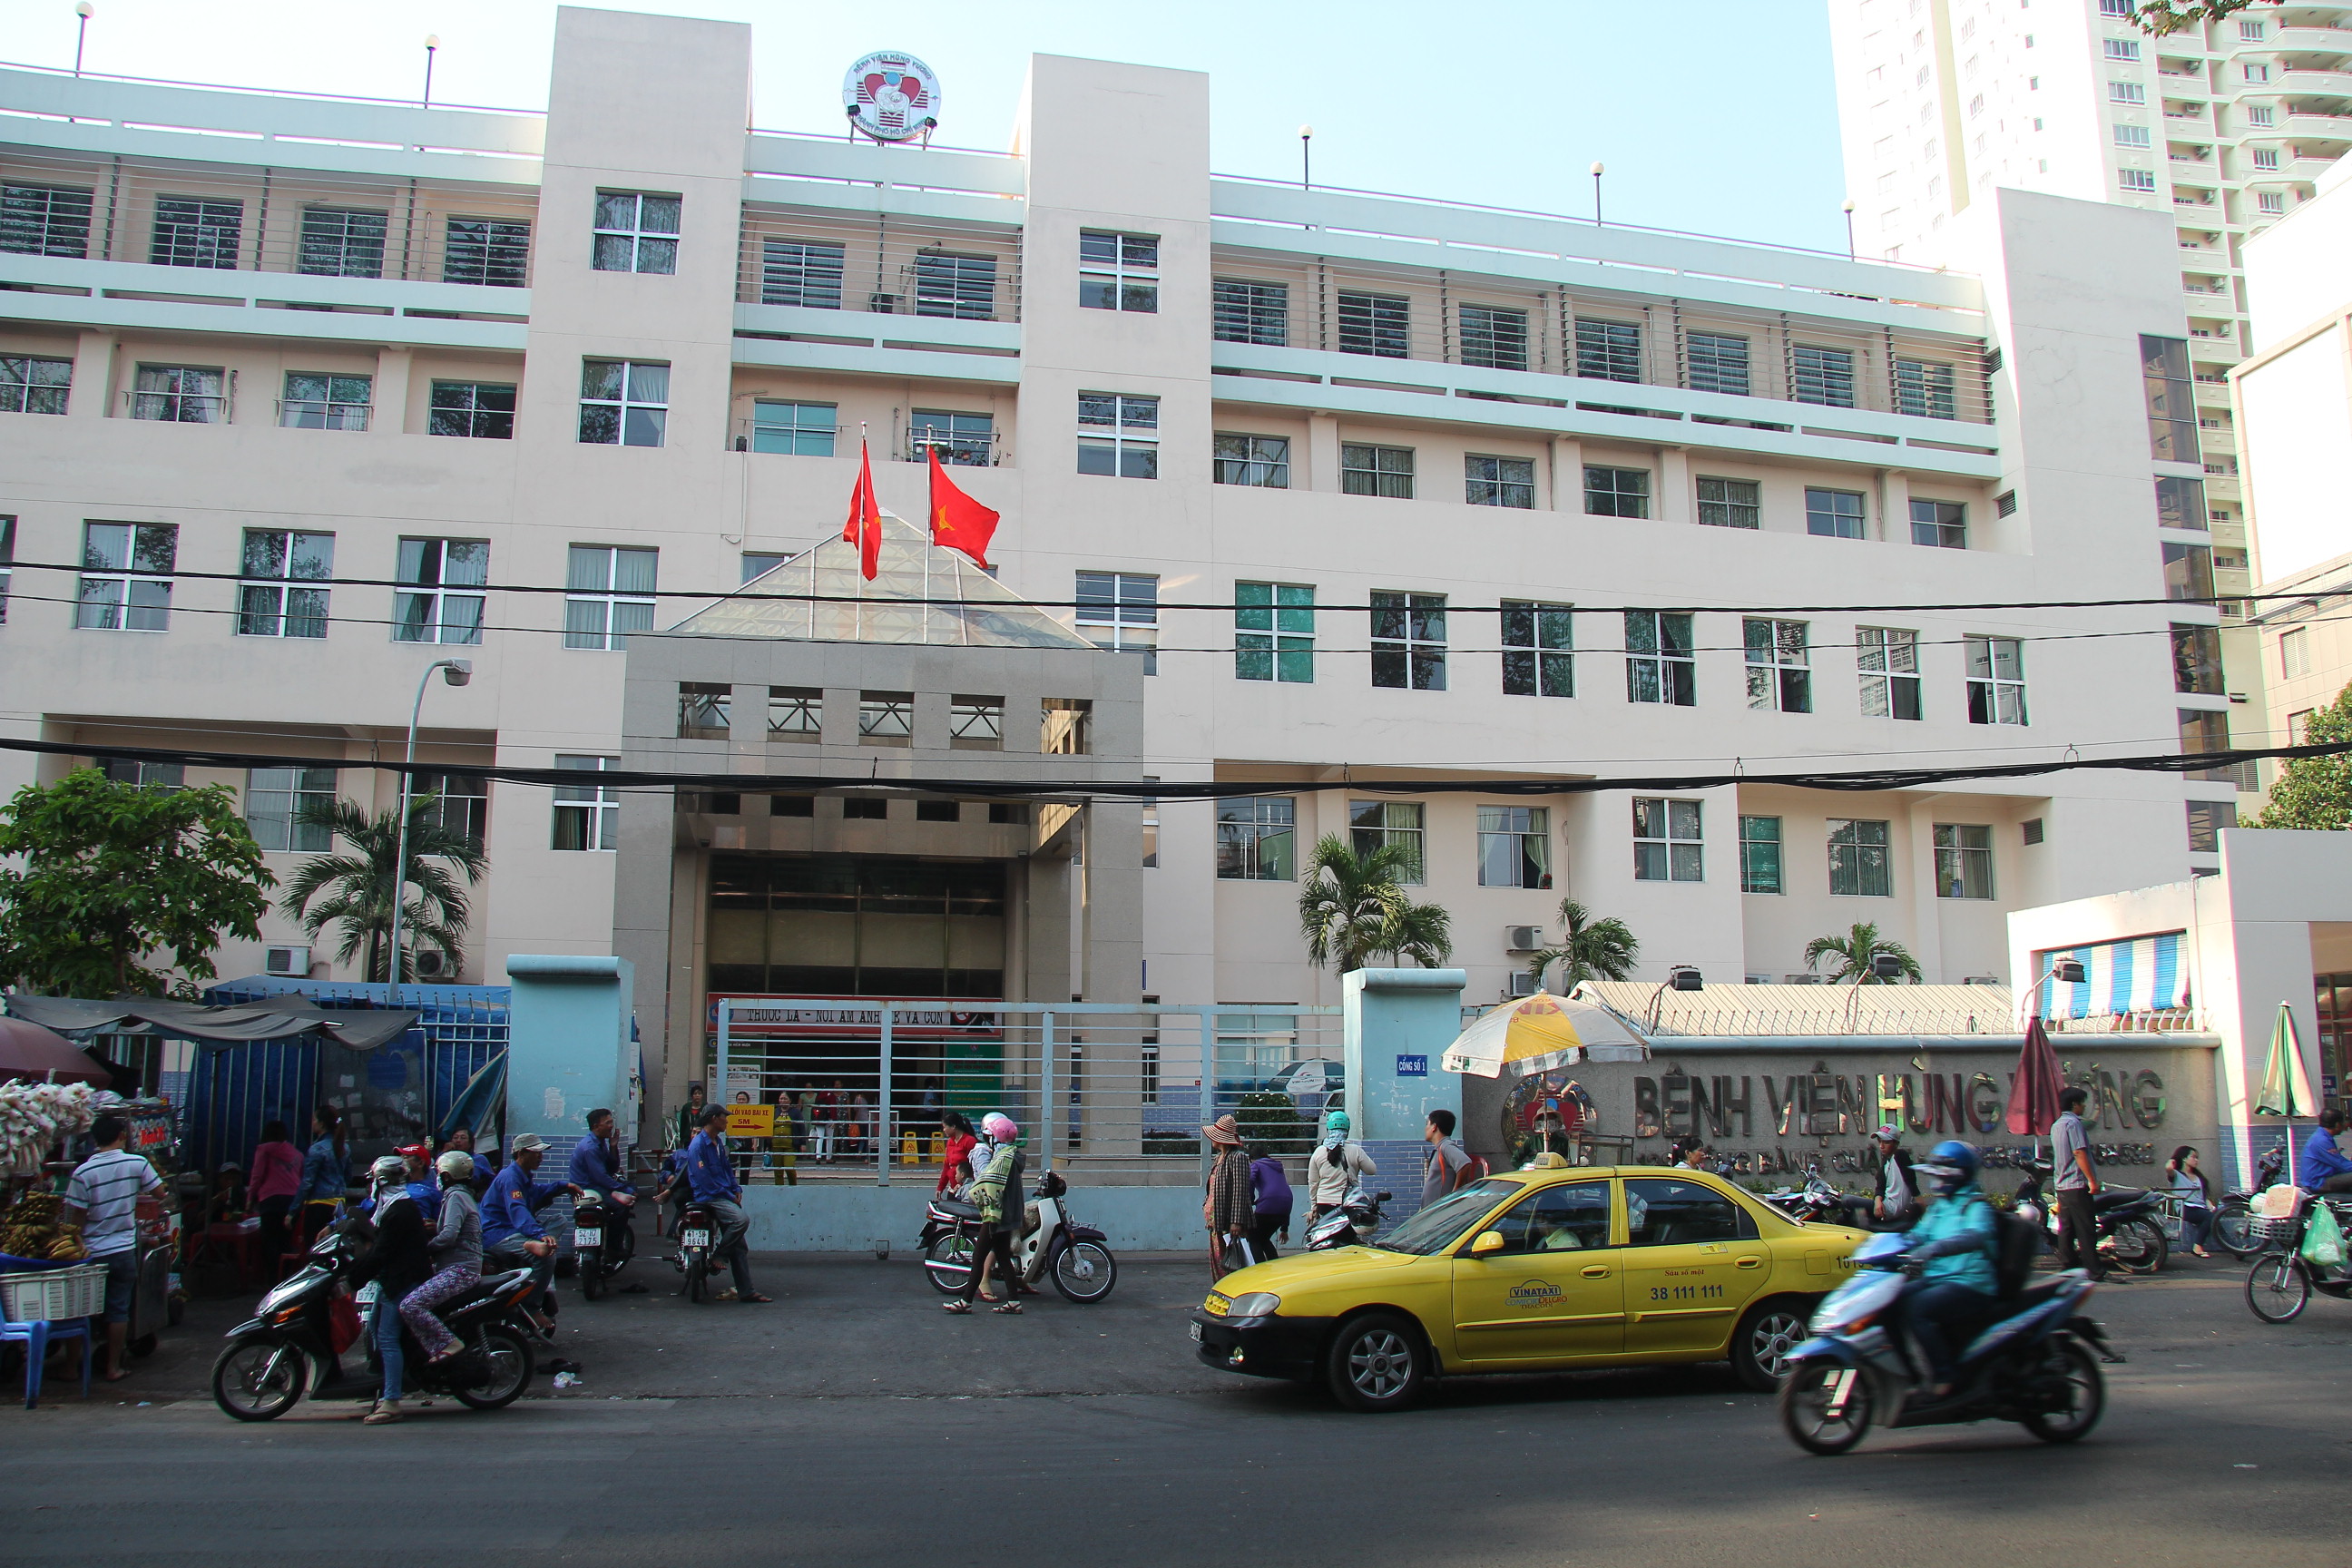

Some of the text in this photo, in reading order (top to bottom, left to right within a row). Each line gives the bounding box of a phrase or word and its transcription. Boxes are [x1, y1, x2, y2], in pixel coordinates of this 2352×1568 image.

[1422, 1062, 1426, 1071] 1
[1876, 1056, 2001, 1133] HÙNG
[579, 1237, 597, 1245] 2175
[1514, 1287, 1558, 1296] VINATAXI
[1651, 1284, 1722, 1299] 38 111 111
